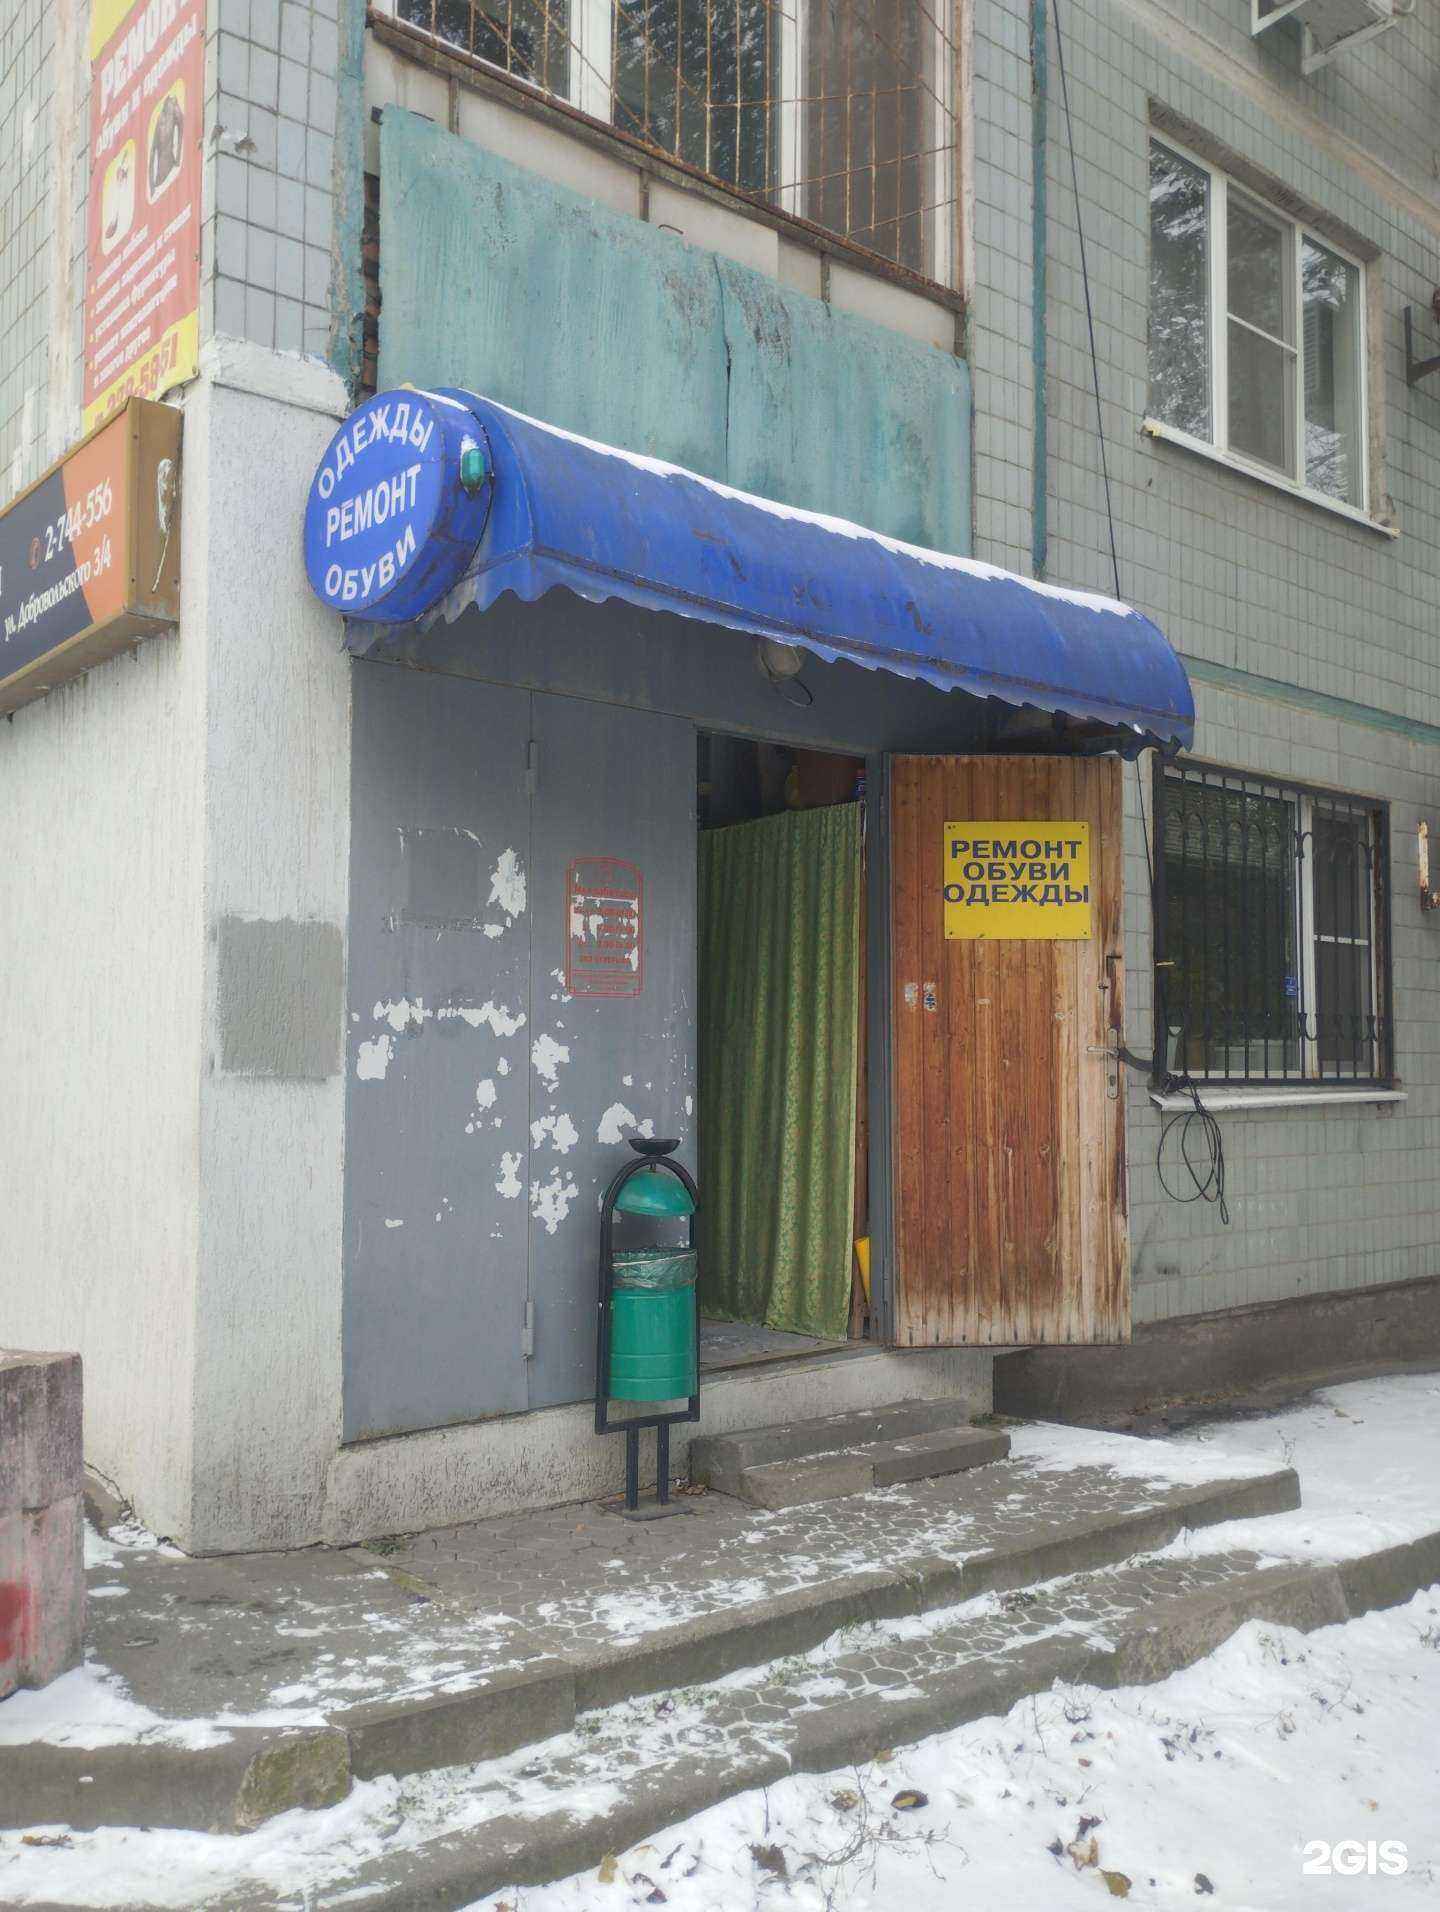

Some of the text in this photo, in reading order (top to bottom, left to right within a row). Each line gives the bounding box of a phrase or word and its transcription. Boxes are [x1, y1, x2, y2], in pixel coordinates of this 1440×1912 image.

[318, 403, 434, 499] ОДЕЖДЫ
[44, 477, 112, 562] 2-744-556
[326, 464, 422, 548] РЕМОНТ
[93, 534, 111, 577] 3/4
[325, 524, 416, 601] ОБУВИ
[951, 840, 1082, 859] РЕМОНТ
[963, 861, 1069, 881] ОБУВИ
[943, 884, 1088, 906] ОДЕЖДЫ
